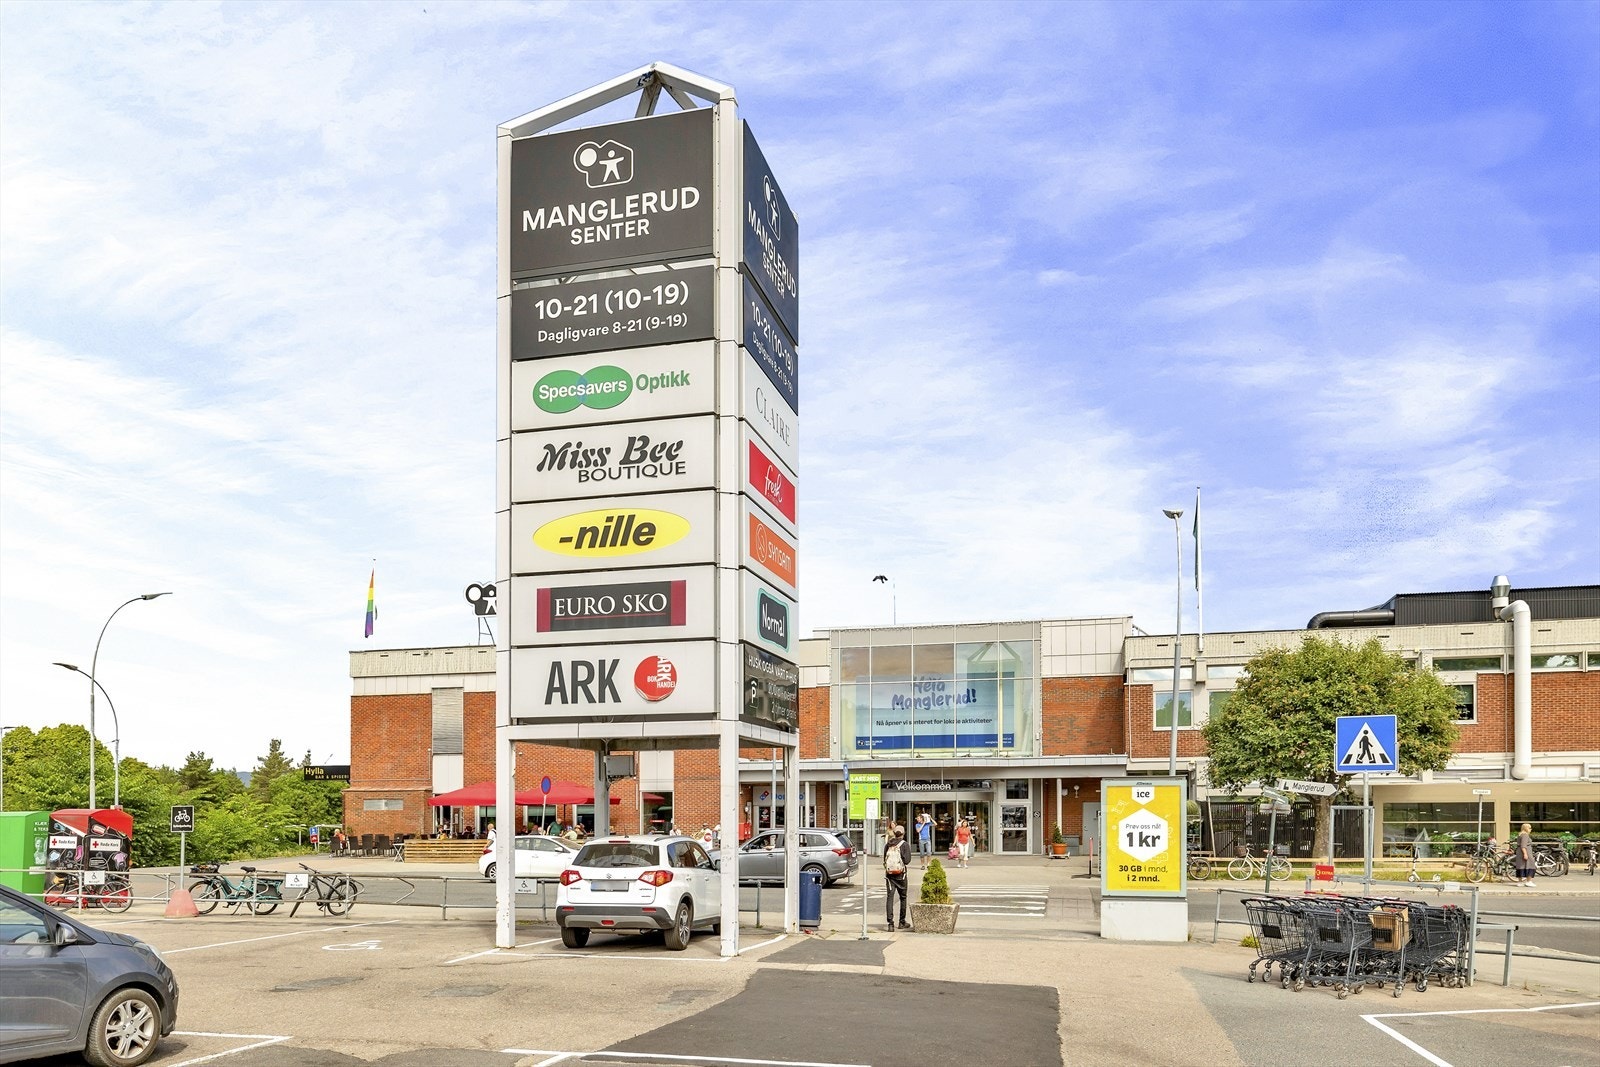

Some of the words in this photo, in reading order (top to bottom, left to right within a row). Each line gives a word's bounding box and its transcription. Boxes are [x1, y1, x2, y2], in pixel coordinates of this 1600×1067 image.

[522, 186, 700, 232] MANGLERUD
[570, 218, 650, 245] SENTER
[748, 200, 797, 298] MANGLERUD
[762, 251, 785, 299] SENTER
[534, 293, 598, 320] 10-21
[605, 280, 689, 315] (10-19)
[537, 325, 610, 343] Dagligvare
[612, 318, 643, 334] 8-21
[645, 312, 688, 331] (9-19)
[751, 301, 771, 343] 10-21
[771, 329, 794, 377] (10-19)
[753, 331, 773, 368] Dagligvare
[538, 378, 628, 402] Specsavers
[635, 369, 691, 393] Optikk
[755, 387, 790, 447] CLAIRE
[536, 441, 612, 473] Miss
[619, 435, 684, 466] Bee
[578, 461, 687, 483] BOUTIQUE
[765, 464, 783, 503] fresh
[559, 514, 657, 550] -nille
[768, 541, 792, 574] synsam
[554, 595, 616, 617] EURO
[622, 592, 668, 613] SKO
[762, 602, 785, 638] Normal
[657, 655, 672, 682] ARK
[748, 654, 762, 671] HUSK
[544, 658, 622, 706] ARK
[646, 675, 658, 683] BOK
[891, 688, 977, 711] Manglerud!
[885, 719, 902, 727] åpner
[305, 767, 324, 776] Hylla
[895, 781, 952, 791] Velkommen
[1136, 789, 1150, 798] ice
[1292, 782, 1325, 793] Manglerud
[1126, 831, 1133, 848] 1
[1138, 831, 1161, 848] kr
[1148, 865, 1168, 873] mnd,
